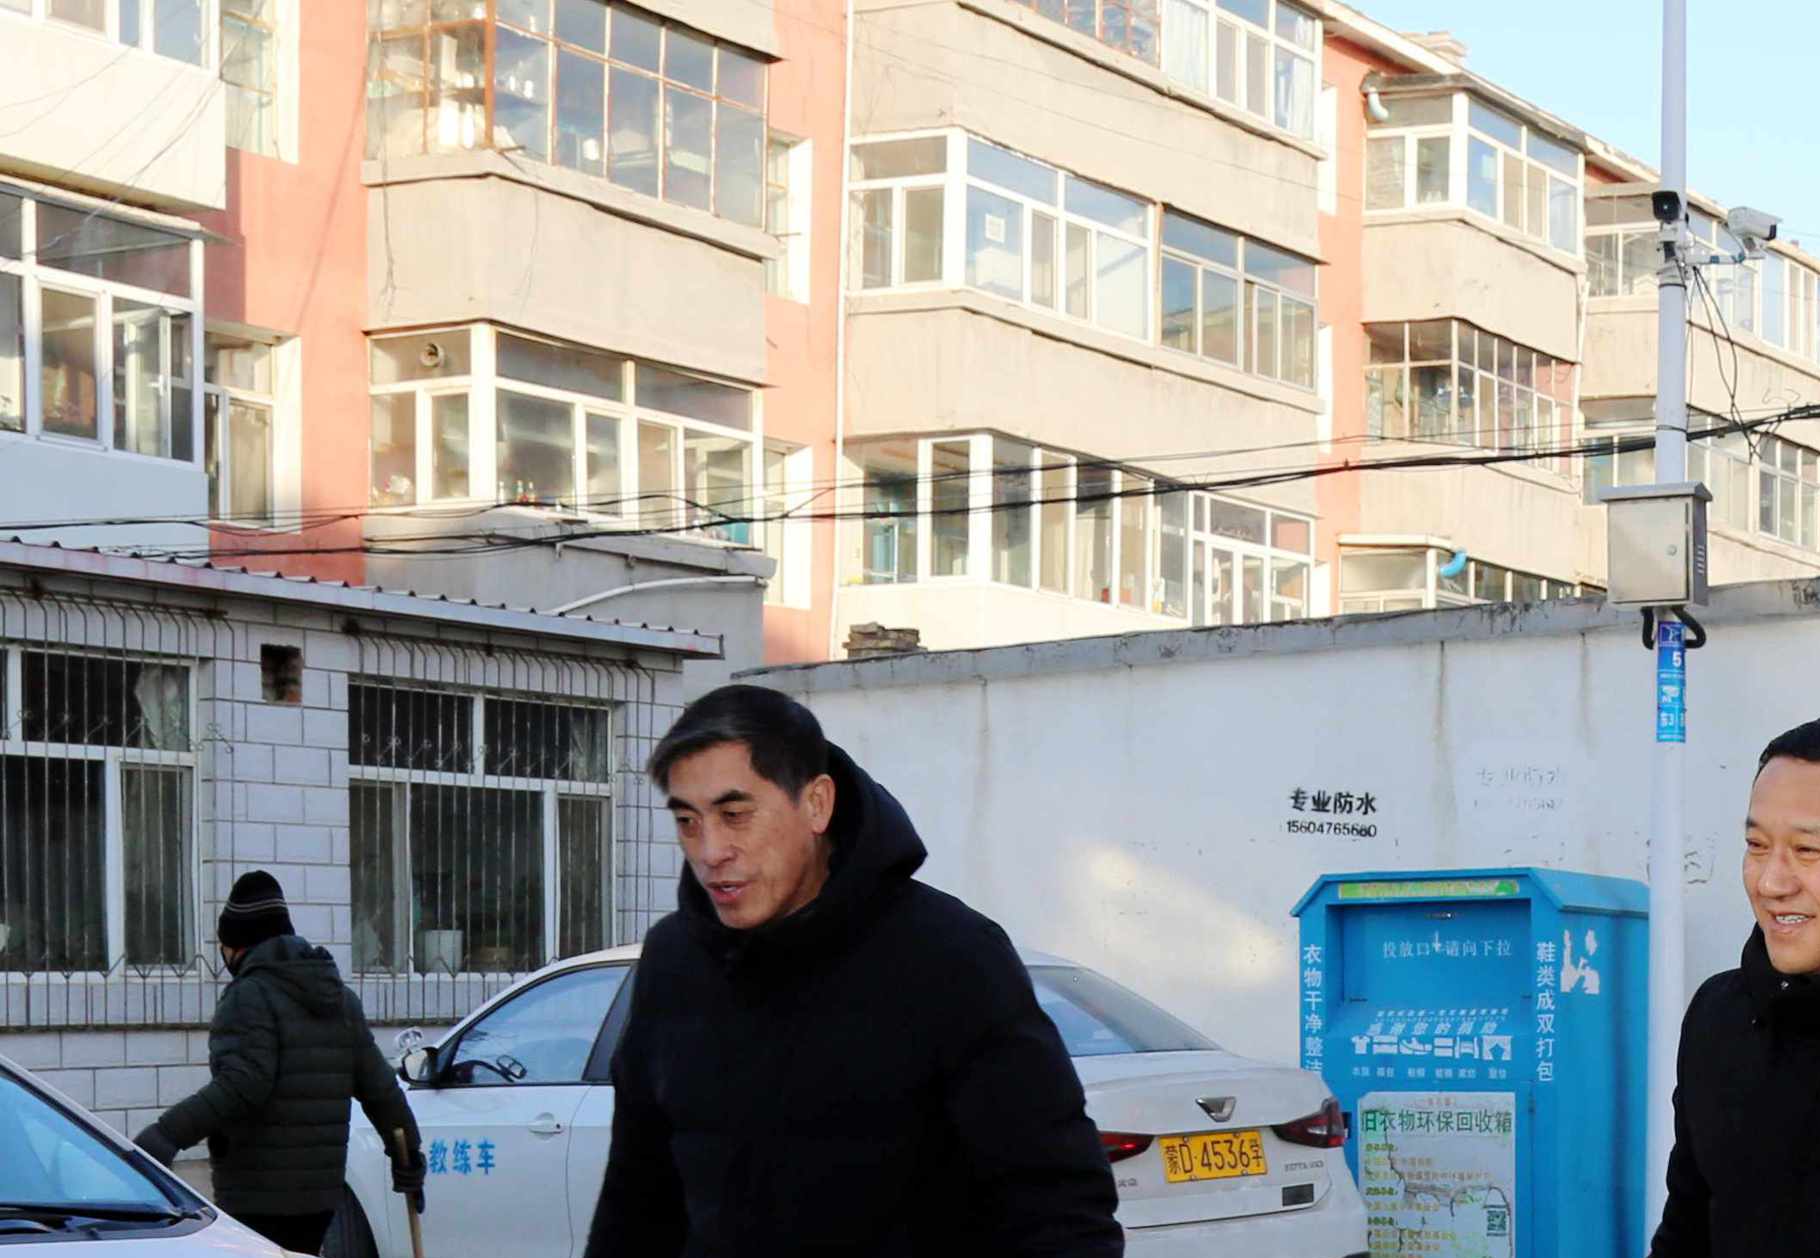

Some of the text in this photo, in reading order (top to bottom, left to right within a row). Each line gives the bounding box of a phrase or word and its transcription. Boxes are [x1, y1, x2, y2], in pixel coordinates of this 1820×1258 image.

[1290, 787, 1376, 815] 专业防水
[1536, 941, 1556, 1081] 鞋类成双打包
[1361, 1108, 1512, 1134] 旧衣物环保回收箱
[429, 1138, 496, 1175] 教练车
